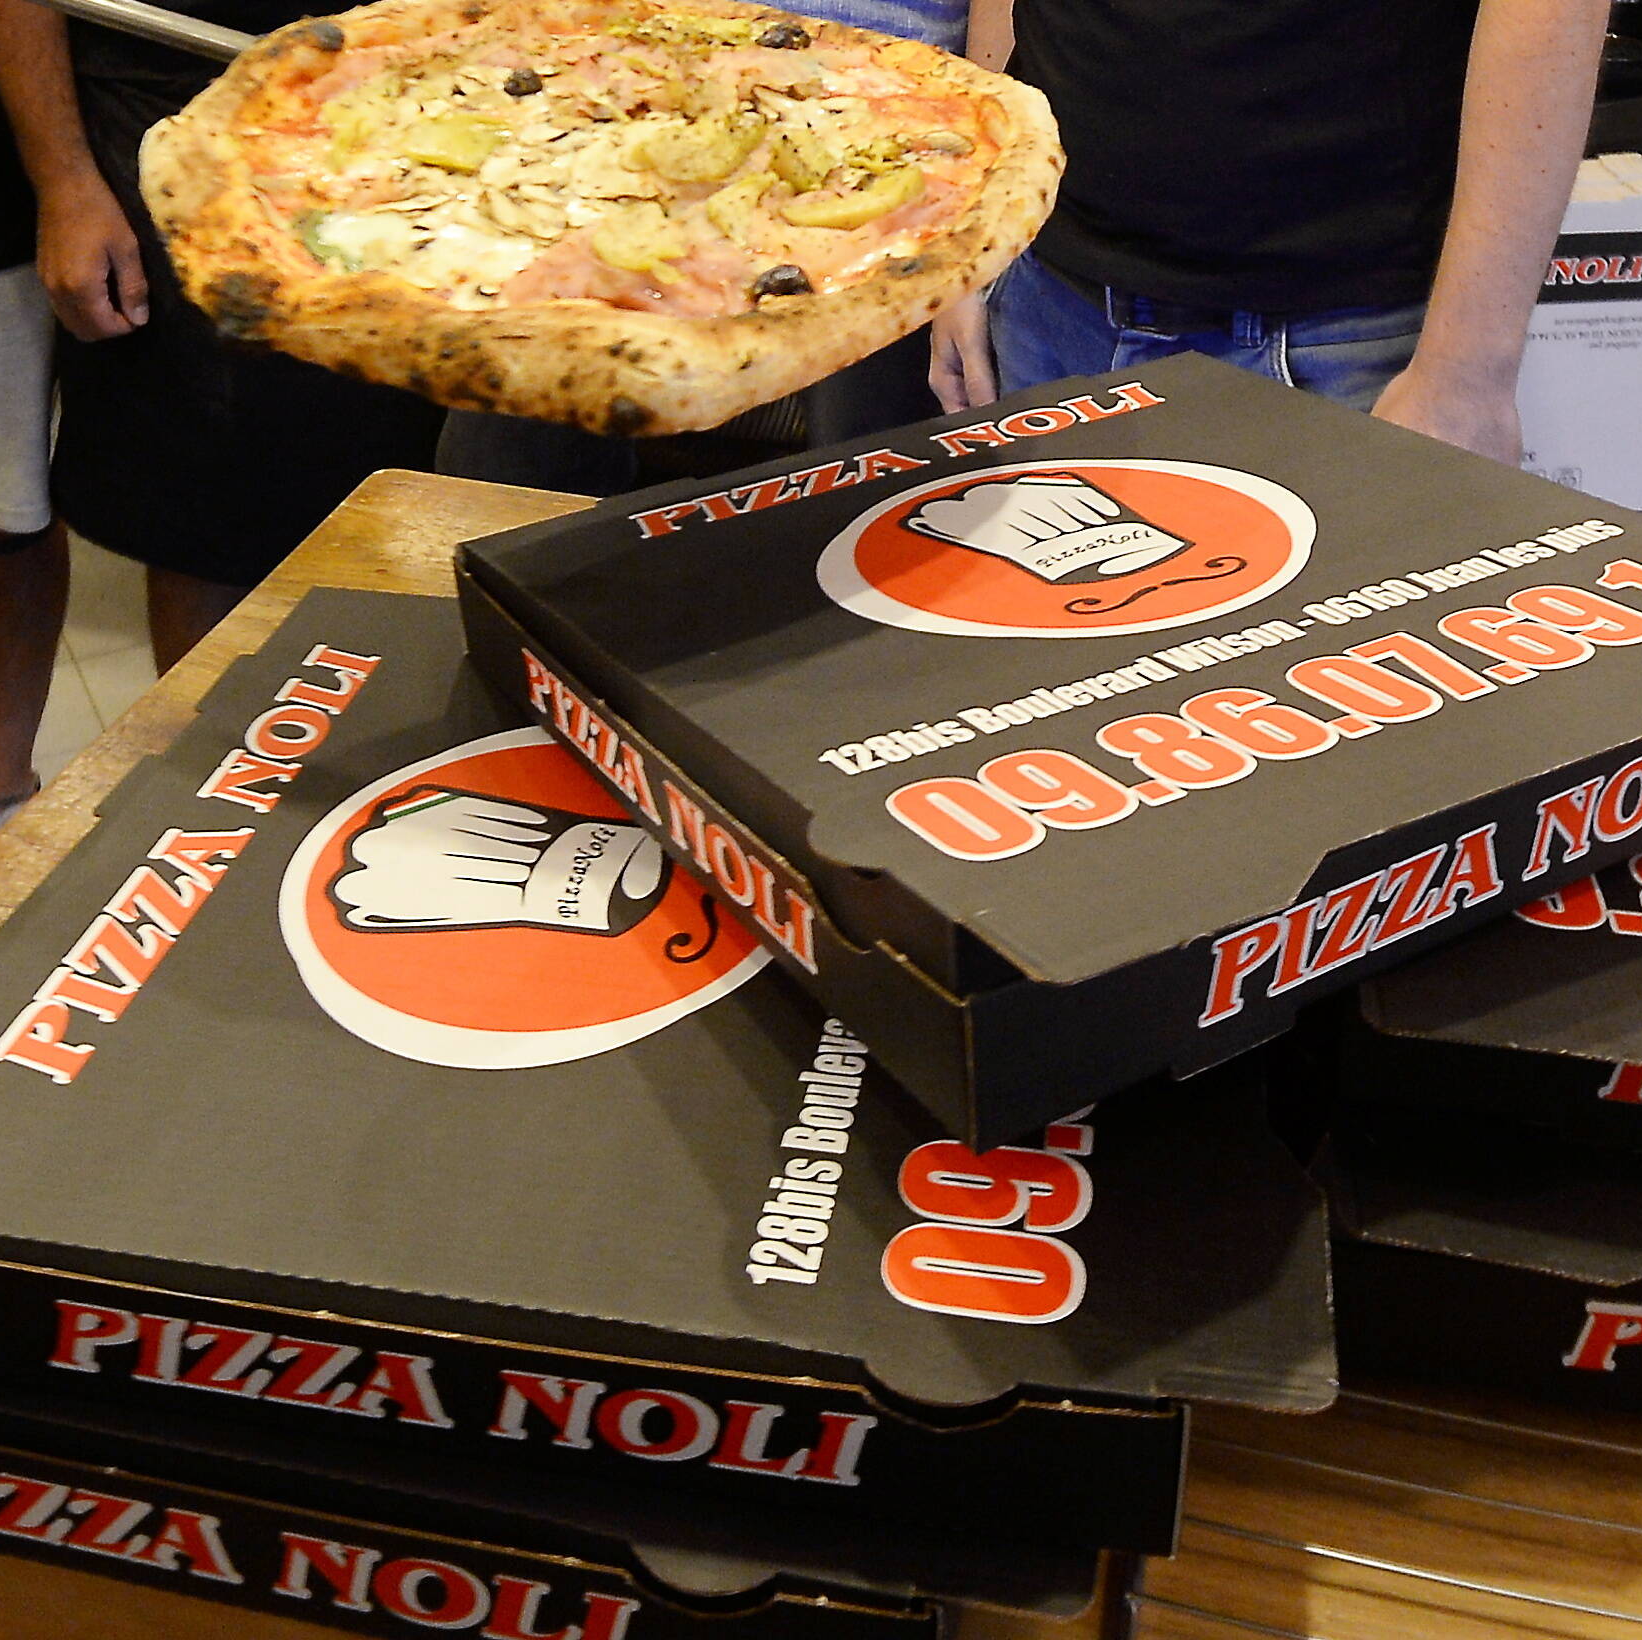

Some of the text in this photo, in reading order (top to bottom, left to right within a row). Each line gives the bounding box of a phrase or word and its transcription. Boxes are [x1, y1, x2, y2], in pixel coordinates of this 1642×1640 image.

[628, 380, 1166, 539] PIZZA NOLI
[196, 642, 383, 814] NOLI
[818, 720, 977, 776] 128bis
[957, 657, 1179, 734] Boulevard
[1168, 619, 1306, 674] Wilson
[1302, 577, 1429, 626] 06160
[1408, 549, 1509, 593] Juan
[1490, 535, 1557, 570] les
[1540, 518, 1625, 556] pins
[520, 647, 820, 976] PIZZA NOLI
[1198, 823, 1506, 1028] PIZZA
[745, 1157, 844, 1285] 128bis
[48, 1298, 878, 1488] PIZZA NOLI
[272, 1530, 642, 1640] NOLI
